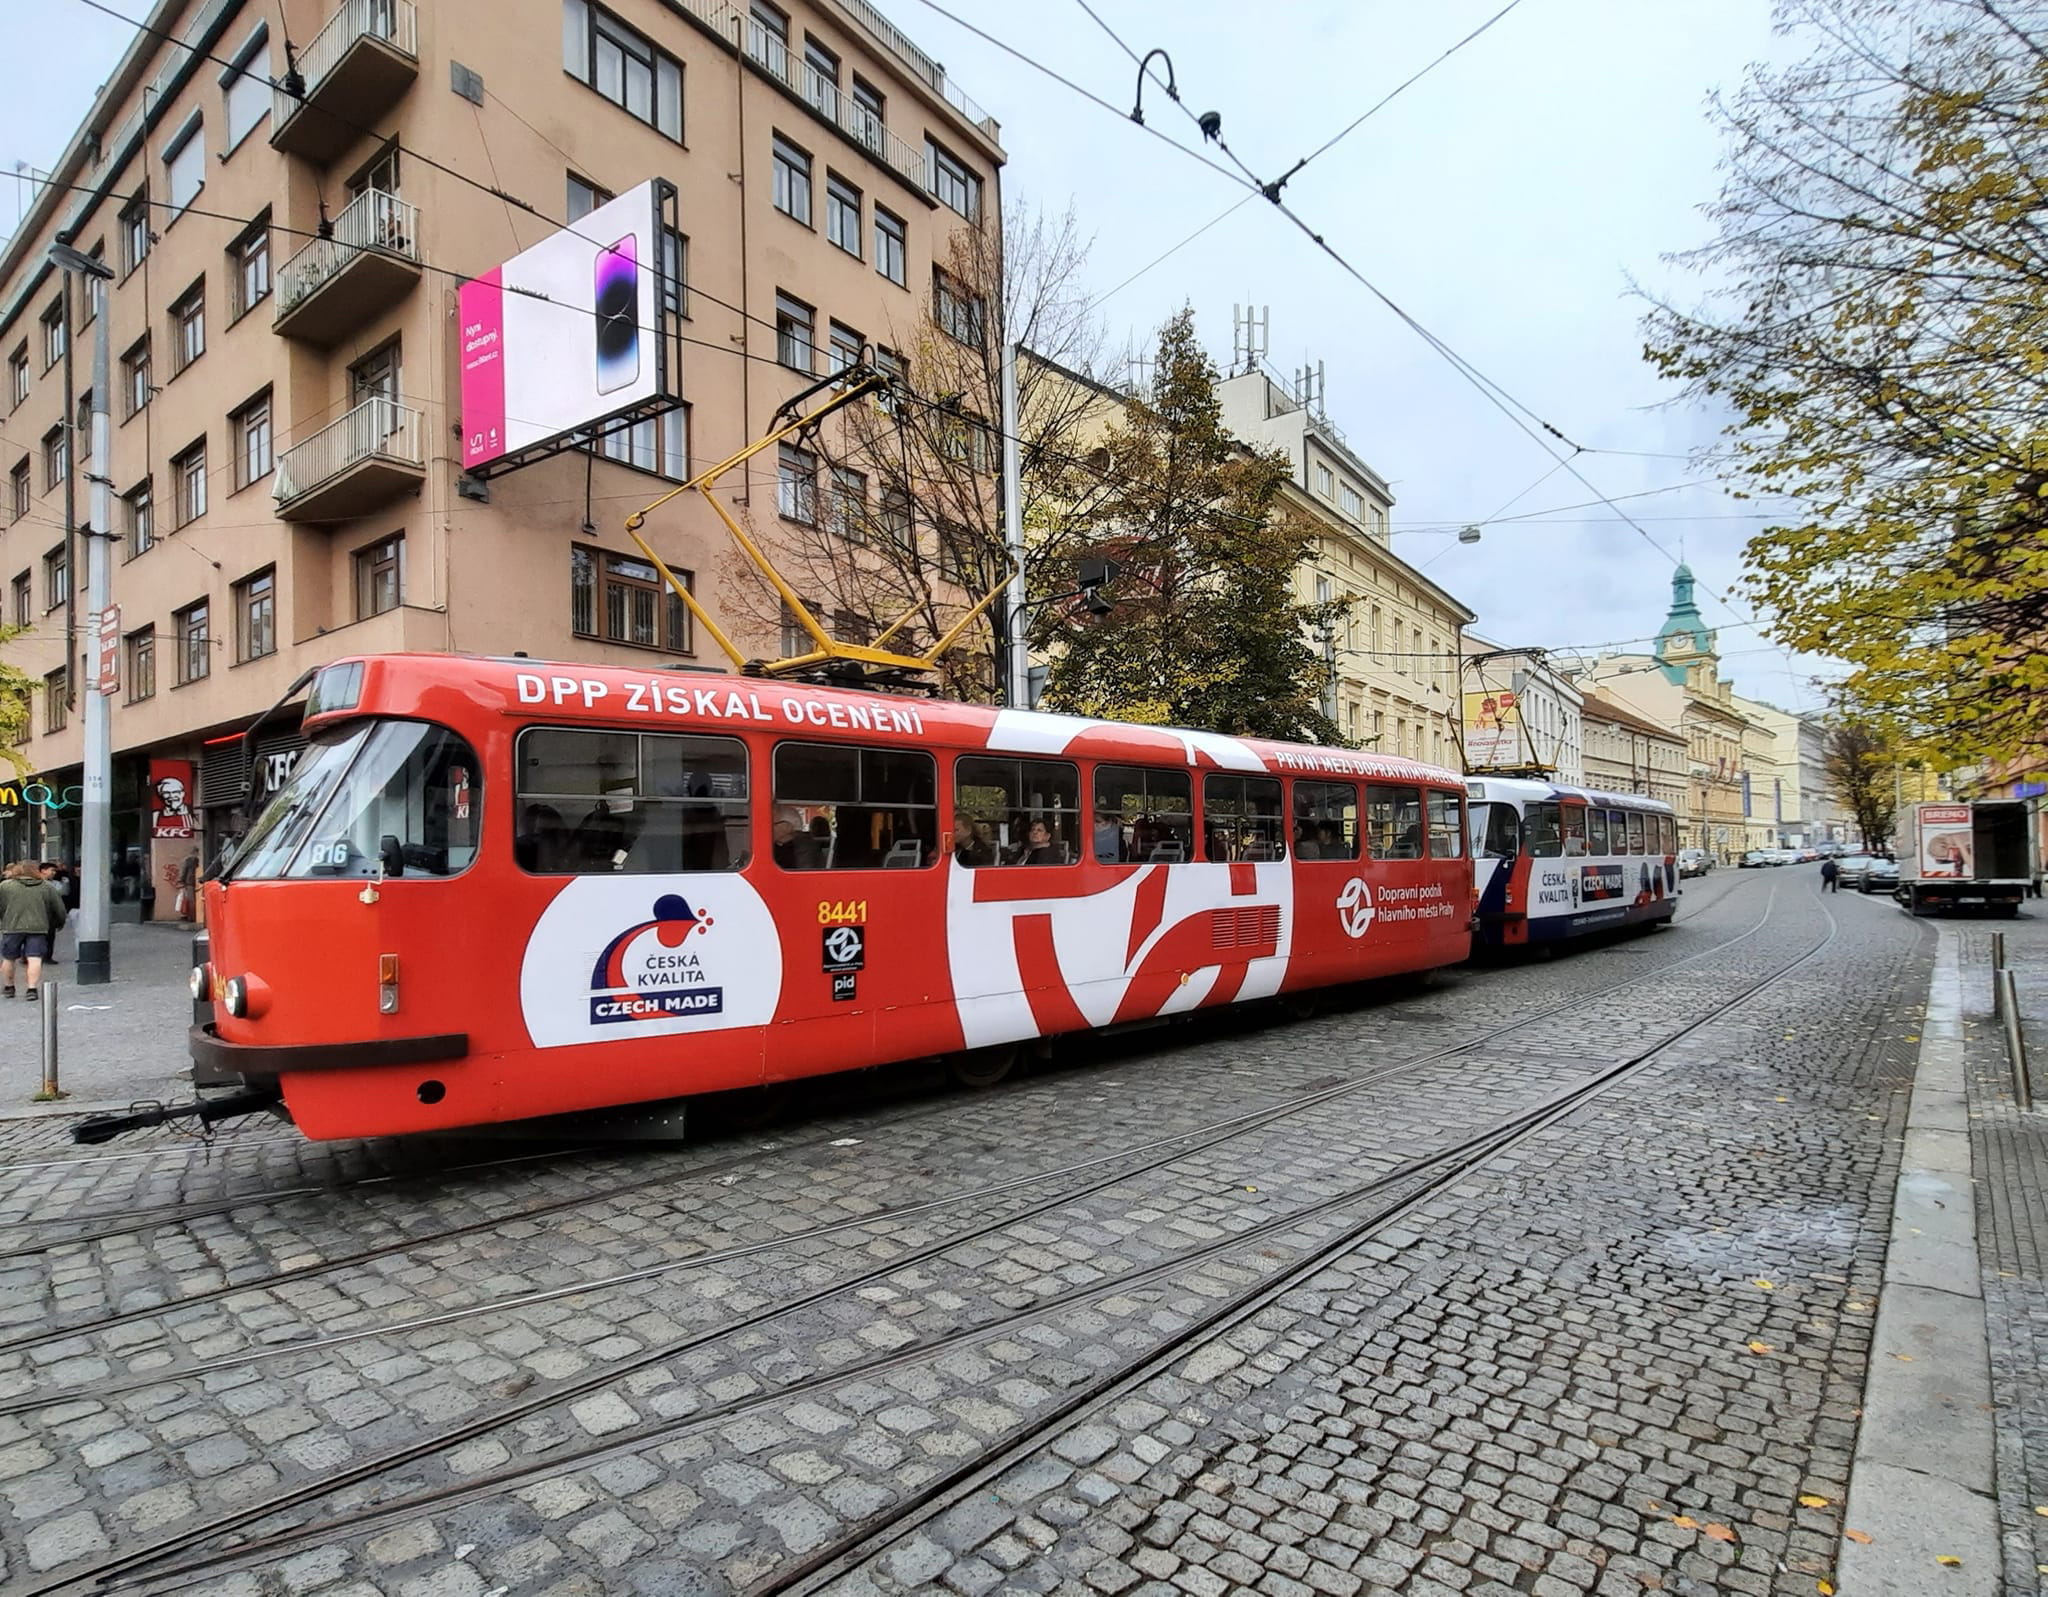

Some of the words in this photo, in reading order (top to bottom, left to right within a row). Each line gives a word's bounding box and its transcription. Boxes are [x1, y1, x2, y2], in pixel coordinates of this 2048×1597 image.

[516, 674, 609, 707] DPP
[623, 680, 773, 721] ZÍSKAL
[783, 698, 924, 735] OCENĚNÍ
[1274, 749, 1319, 770] PRVNÍ
[1324, 757, 1352, 774] MEZI
[156, 828, 190, 837] KFC
[311, 844, 348, 864] 816
[1542, 870, 1566, 887] ČESKÁ
[1583, 876, 1604, 892] CZECH
[1604, 874, 1622, 890] MADE
[1378, 884, 1418, 904] Dopravní
[1419, 882, 1442, 902] podnik
[1539, 889, 1569, 904] KVALITA
[818, 900, 867, 924] 8441
[1378, 905, 1417, 922] hlavního
[1417, 903, 1439, 920] města
[1439, 901, 1455, 919] Prahy
[646, 951, 700, 970] ČESKÁ
[638, 970, 705, 987] KVALITA
[834, 975, 855, 993] pid
[595, 999, 659, 1017] CZECH
[665, 994, 718, 1011] MADE
